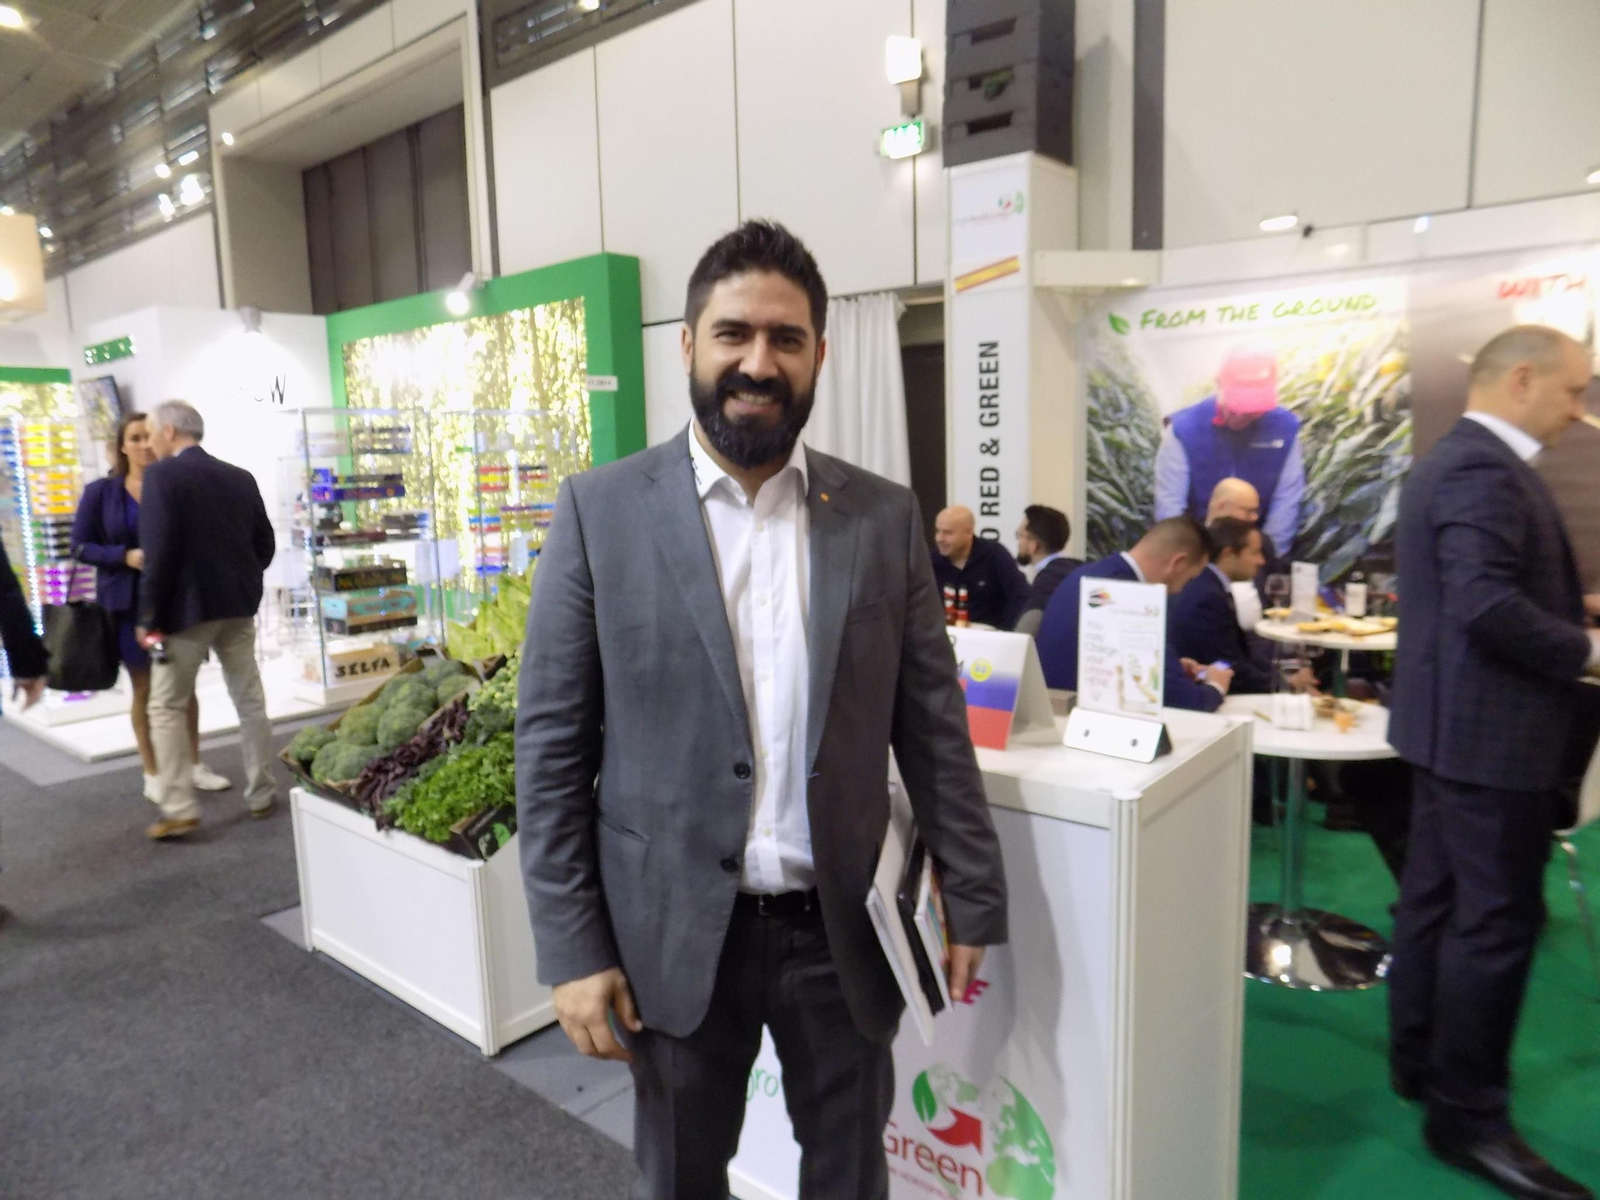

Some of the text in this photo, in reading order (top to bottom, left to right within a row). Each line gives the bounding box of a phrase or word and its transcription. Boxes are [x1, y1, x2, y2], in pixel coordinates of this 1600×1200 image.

[1140, 294, 1377, 330] FROM THE GROUND
[979, 341, 1000, 427] GREEN
[980, 438, 1001, 457] &
[980, 466, 1001, 517] RED
[885, 1120, 983, 1197] Green
